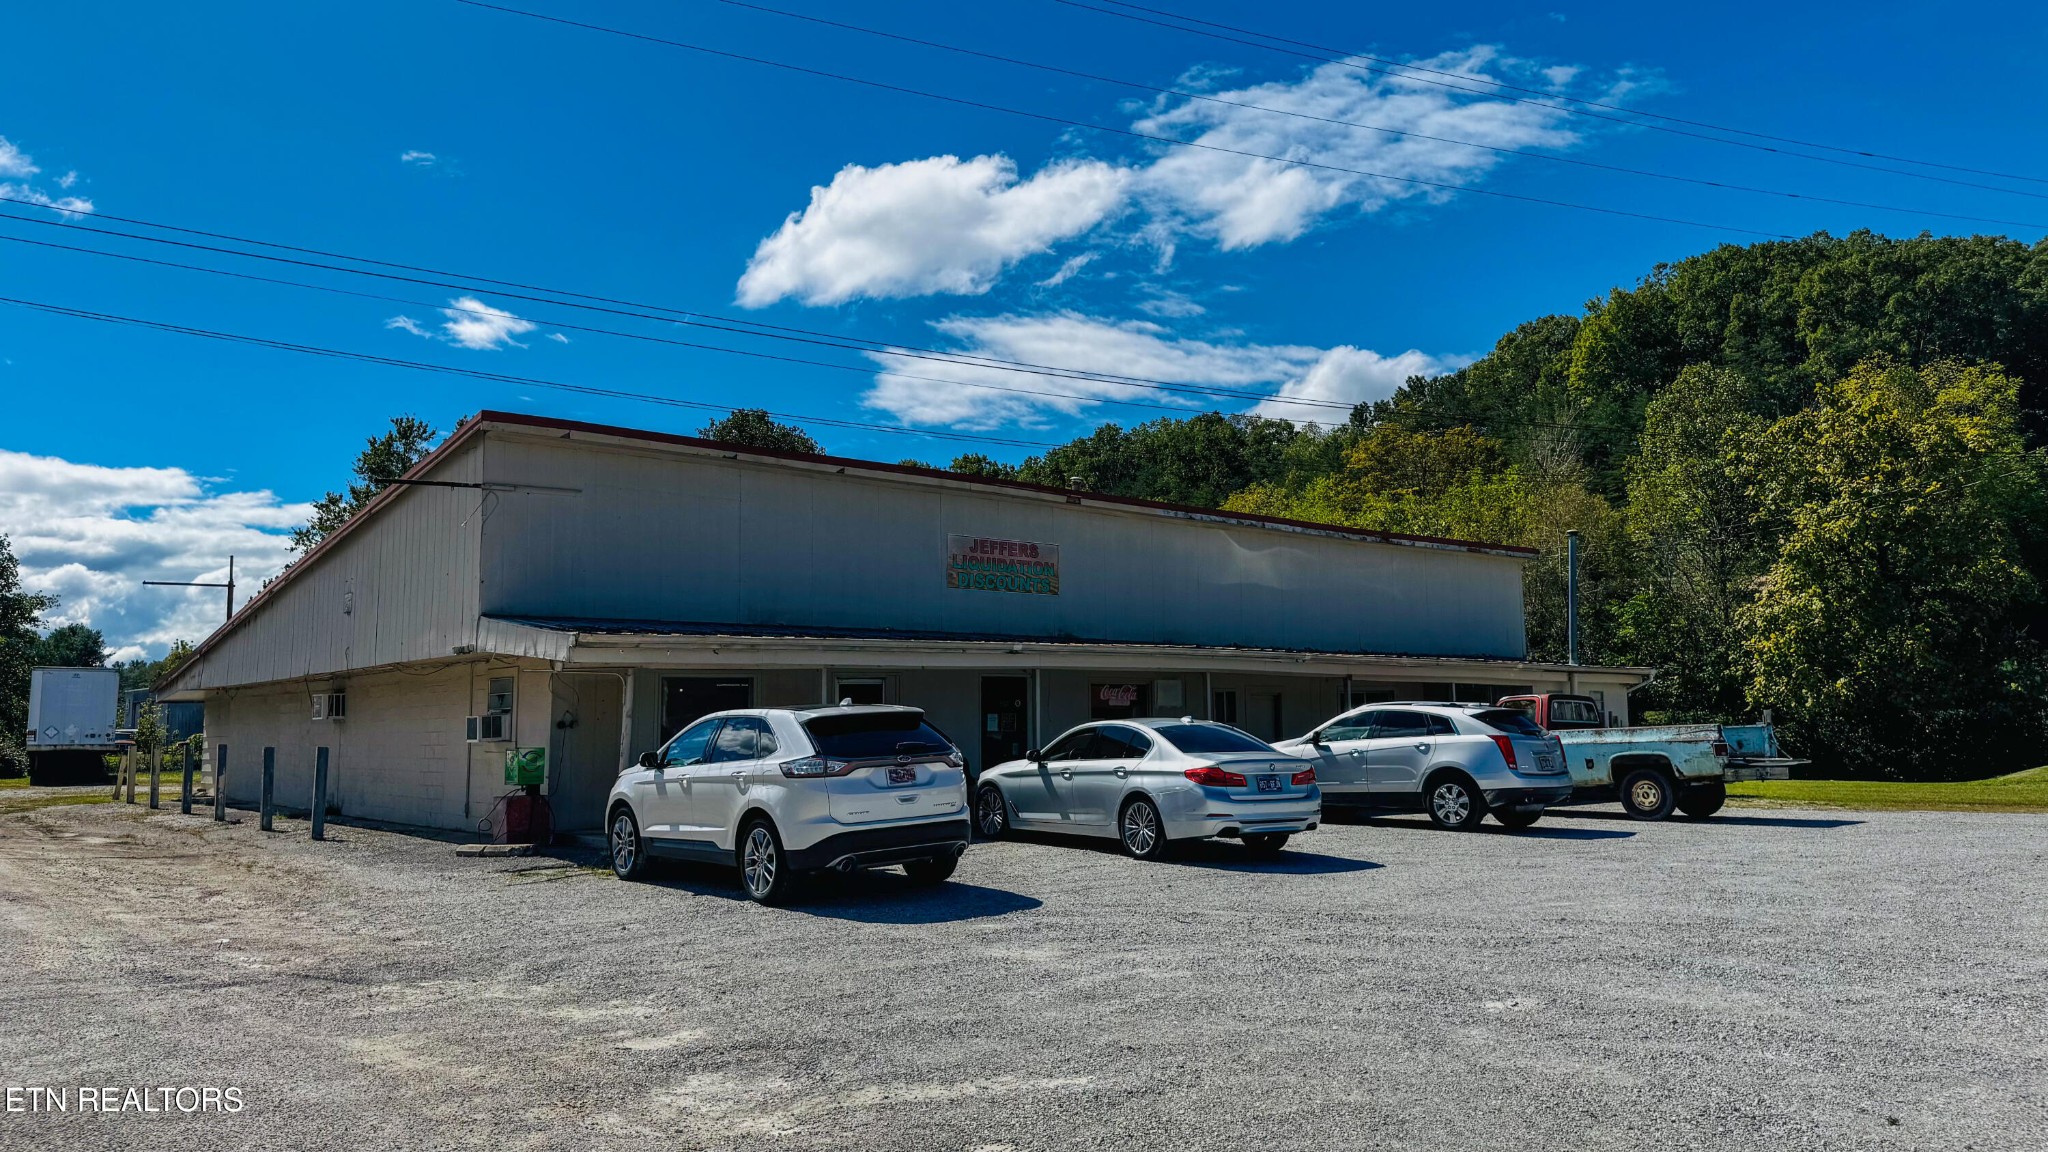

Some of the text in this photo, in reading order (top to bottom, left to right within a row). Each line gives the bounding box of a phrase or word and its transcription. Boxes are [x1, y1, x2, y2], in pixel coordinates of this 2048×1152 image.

[969, 539, 1039, 558] JEFFERS
[952, 554, 1054, 576] LIQUIDATION
[957, 572, 1051, 593] DISCOUNTS
